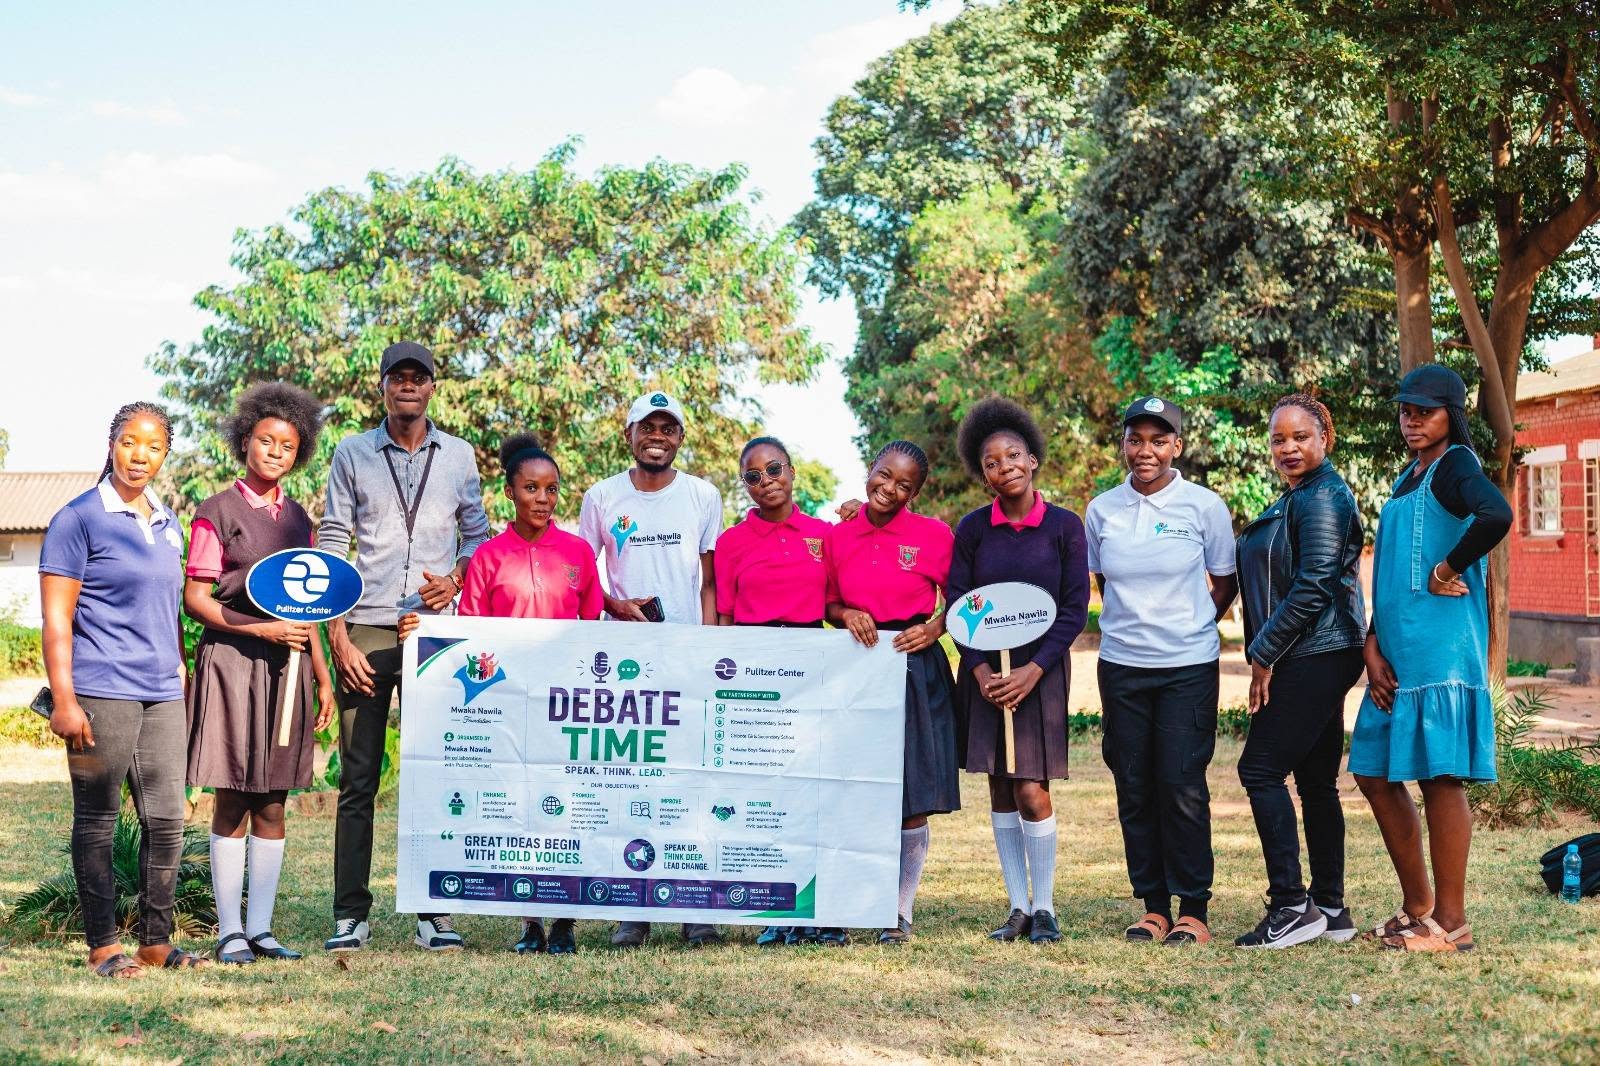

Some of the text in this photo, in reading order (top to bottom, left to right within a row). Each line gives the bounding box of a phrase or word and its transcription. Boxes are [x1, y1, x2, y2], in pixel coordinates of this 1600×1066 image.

[630, 533, 682, 544] Mwaka Nawila
[276, 605, 332, 614] Pulitzer Center
[984, 610, 1048, 625] Mwaka Nawila
[746, 668, 805, 677] Pulitzer Center
[548, 687, 680, 726] DEBATE
[562, 727, 666, 763] TIME
[565, 766, 665, 777] SPEAK. THINK. LEAD.
[465, 835, 580, 850] GREAT IDEAS BEGIN
[465, 849, 582, 864] WITH BOLD VOICES.
[682, 862, 709, 870] CHANGE.
